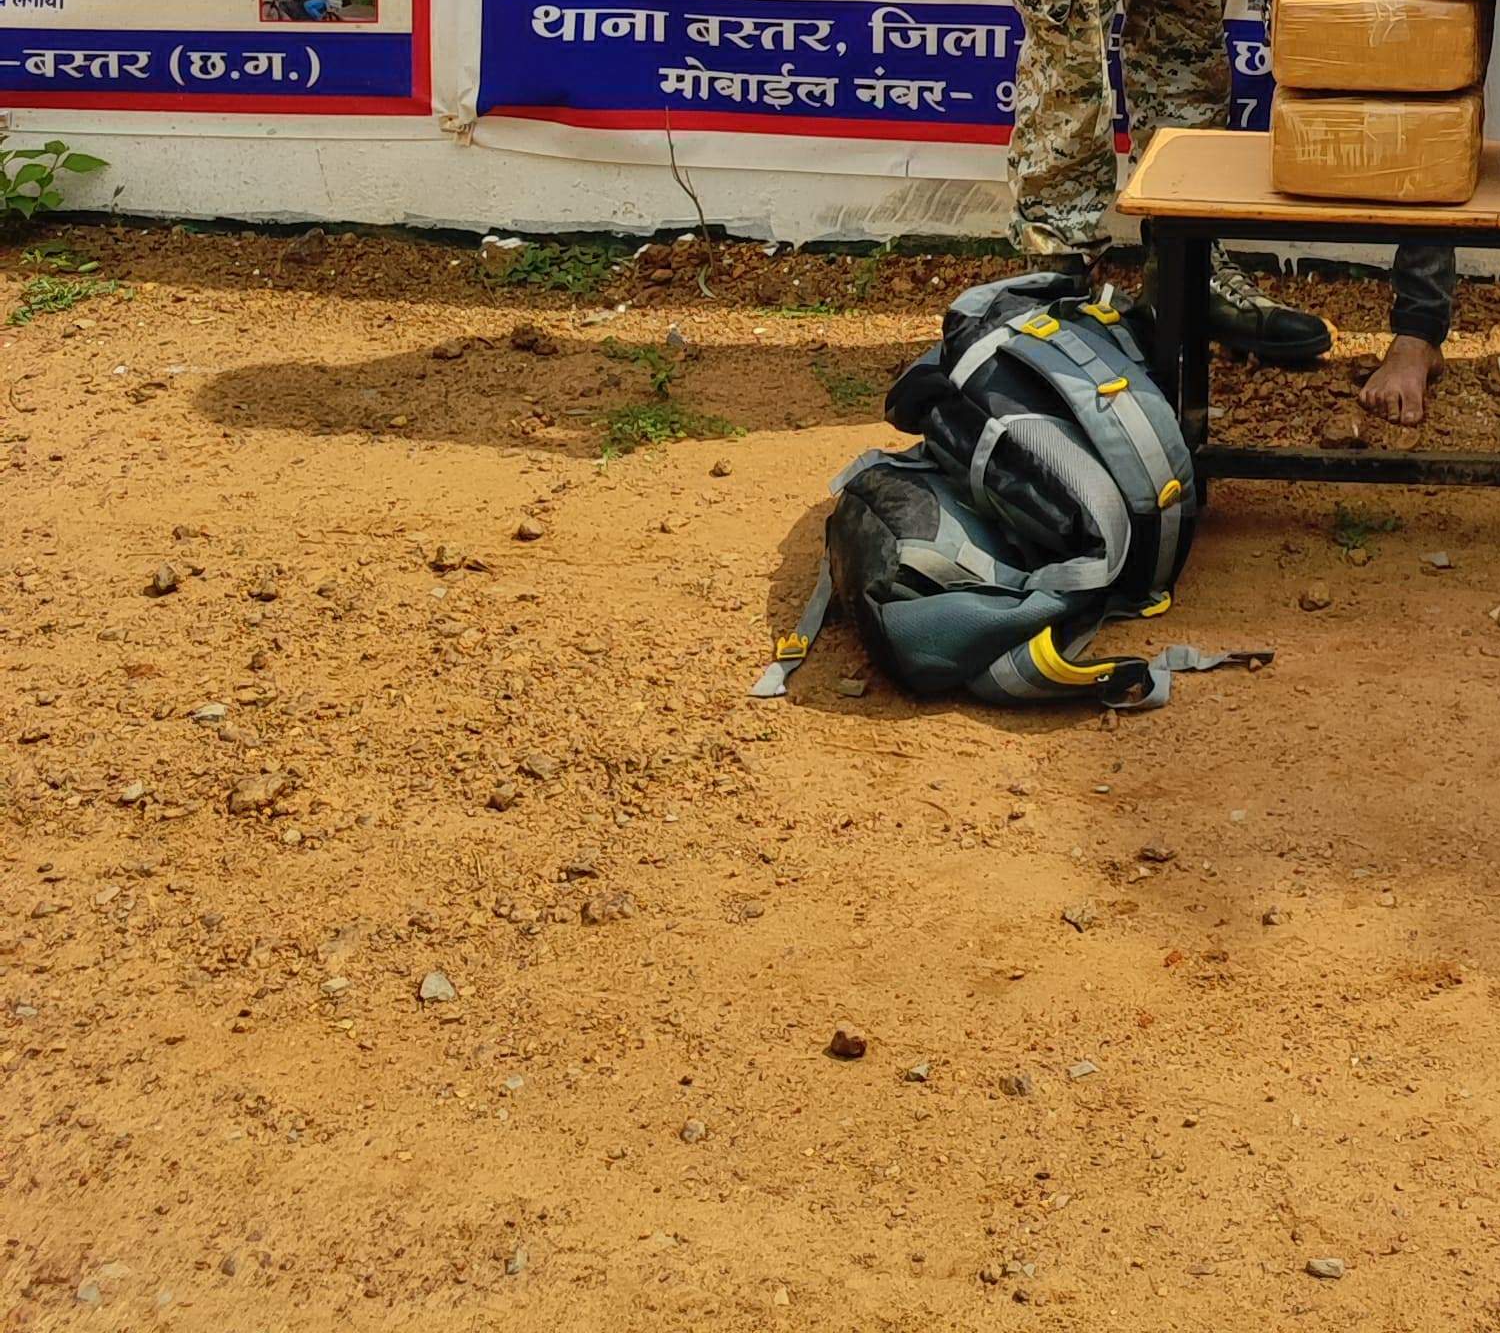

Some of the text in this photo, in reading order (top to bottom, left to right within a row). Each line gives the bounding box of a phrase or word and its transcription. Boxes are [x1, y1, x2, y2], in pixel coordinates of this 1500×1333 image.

[532, 6, 669, 41] थाना
[684, 14, 846, 56] बस्तर,
[169, 45, 321, 88] (छ.ग.)
[659, 57, 838, 110] मोबाईल
